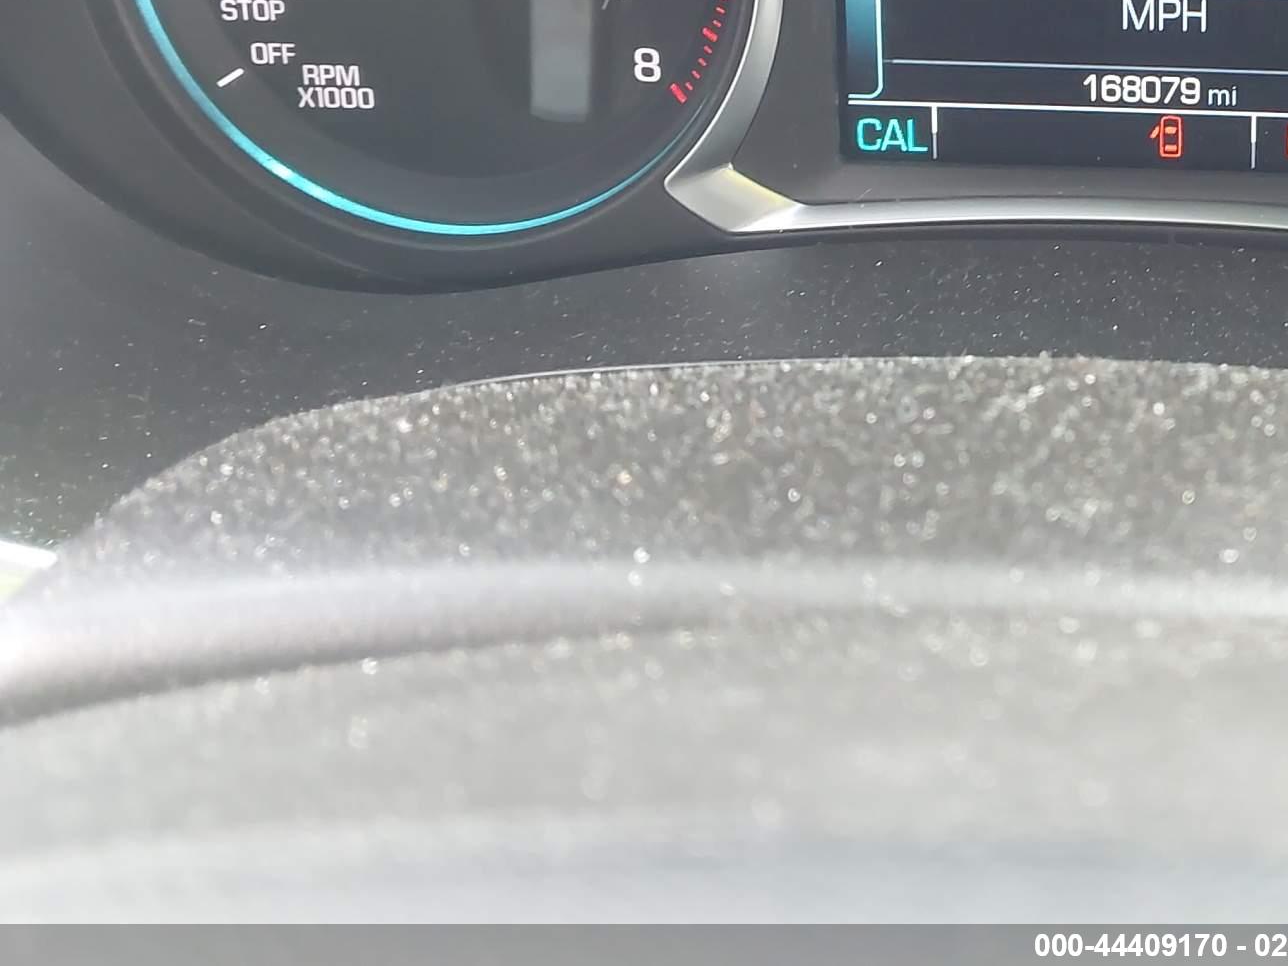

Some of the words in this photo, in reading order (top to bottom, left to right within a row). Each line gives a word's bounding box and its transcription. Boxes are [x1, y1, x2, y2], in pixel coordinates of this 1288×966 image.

[250, 42, 296, 65] OFF
[633, 46, 662, 83] 8
[302, 64, 360, 87] RPM
[298, 87, 375, 110] X1000
[1083, 74, 1201, 106] 168079
[1208, 85, 1238, 106] mi
[855, 117, 928, 153] CAL
